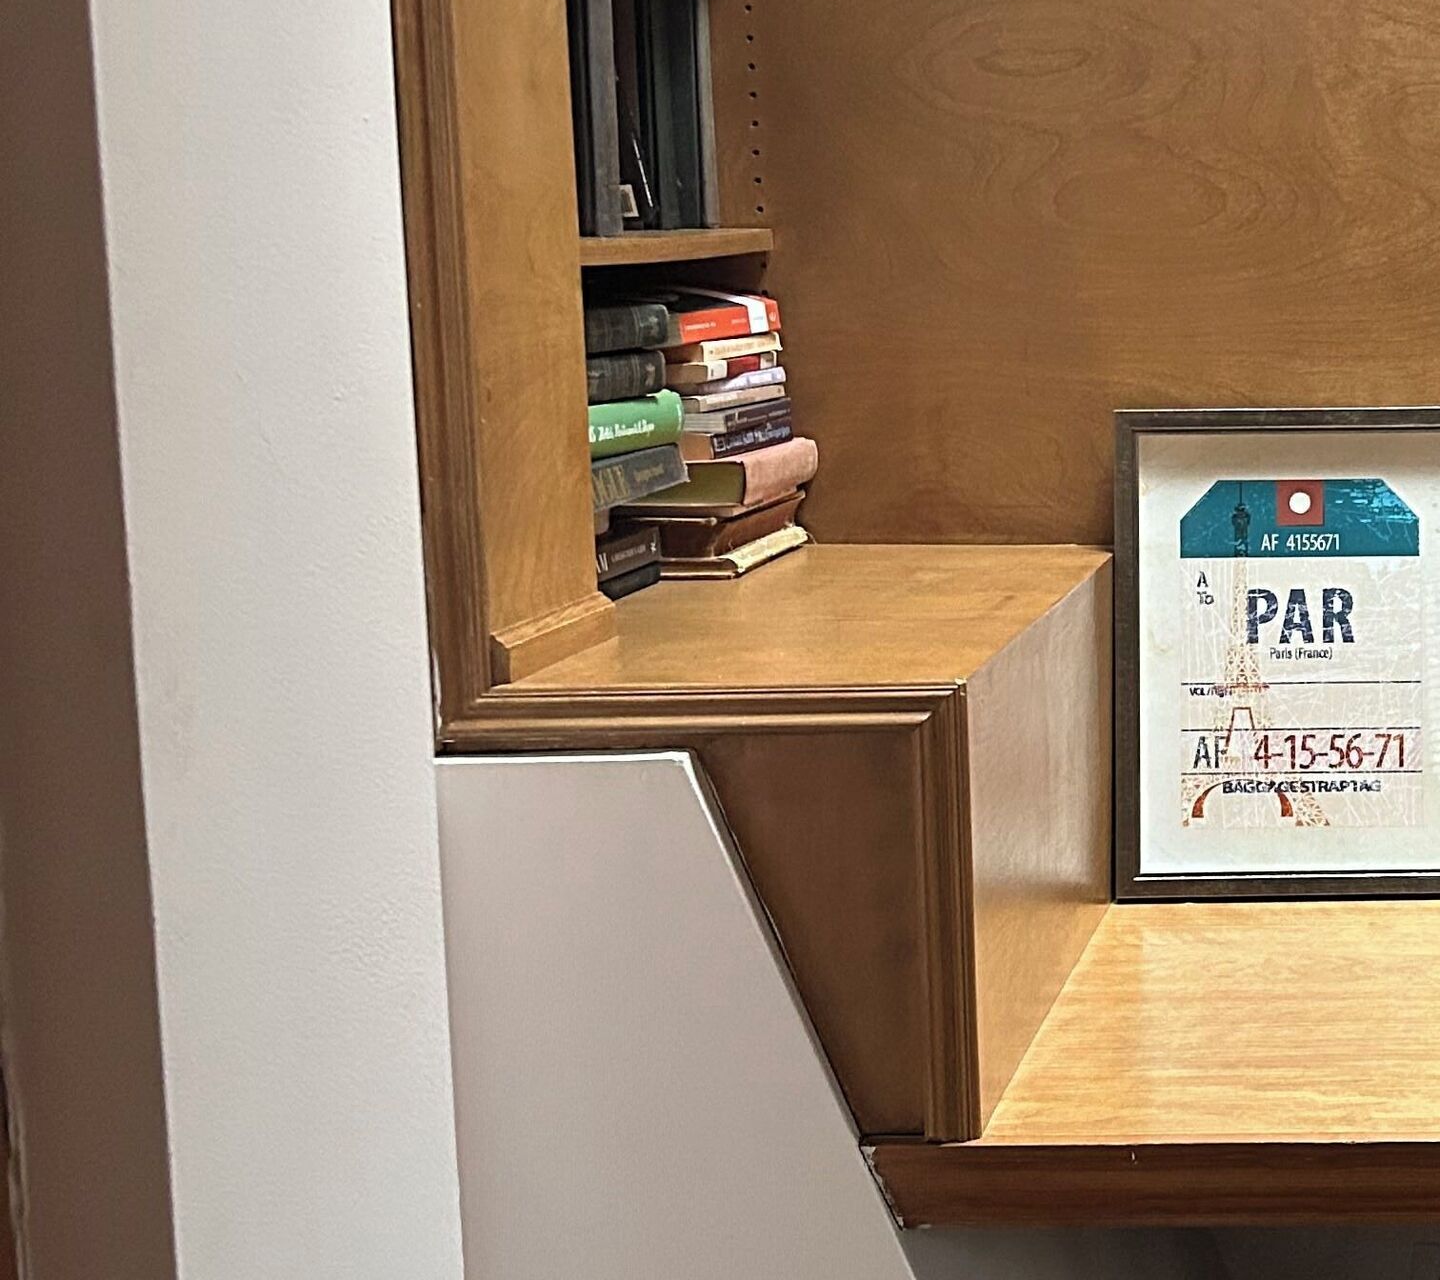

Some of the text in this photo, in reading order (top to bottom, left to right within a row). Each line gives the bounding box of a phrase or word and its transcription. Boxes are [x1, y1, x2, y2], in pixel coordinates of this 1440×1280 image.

[1260, 533, 1340, 551] AF 4155671
[1197, 591, 1215, 605] To
[1246, 588, 1355, 644] PAR
[1269, 646, 1333, 660] Paris (France)
[1193, 733, 1405, 770] AF 4-15-56-71
